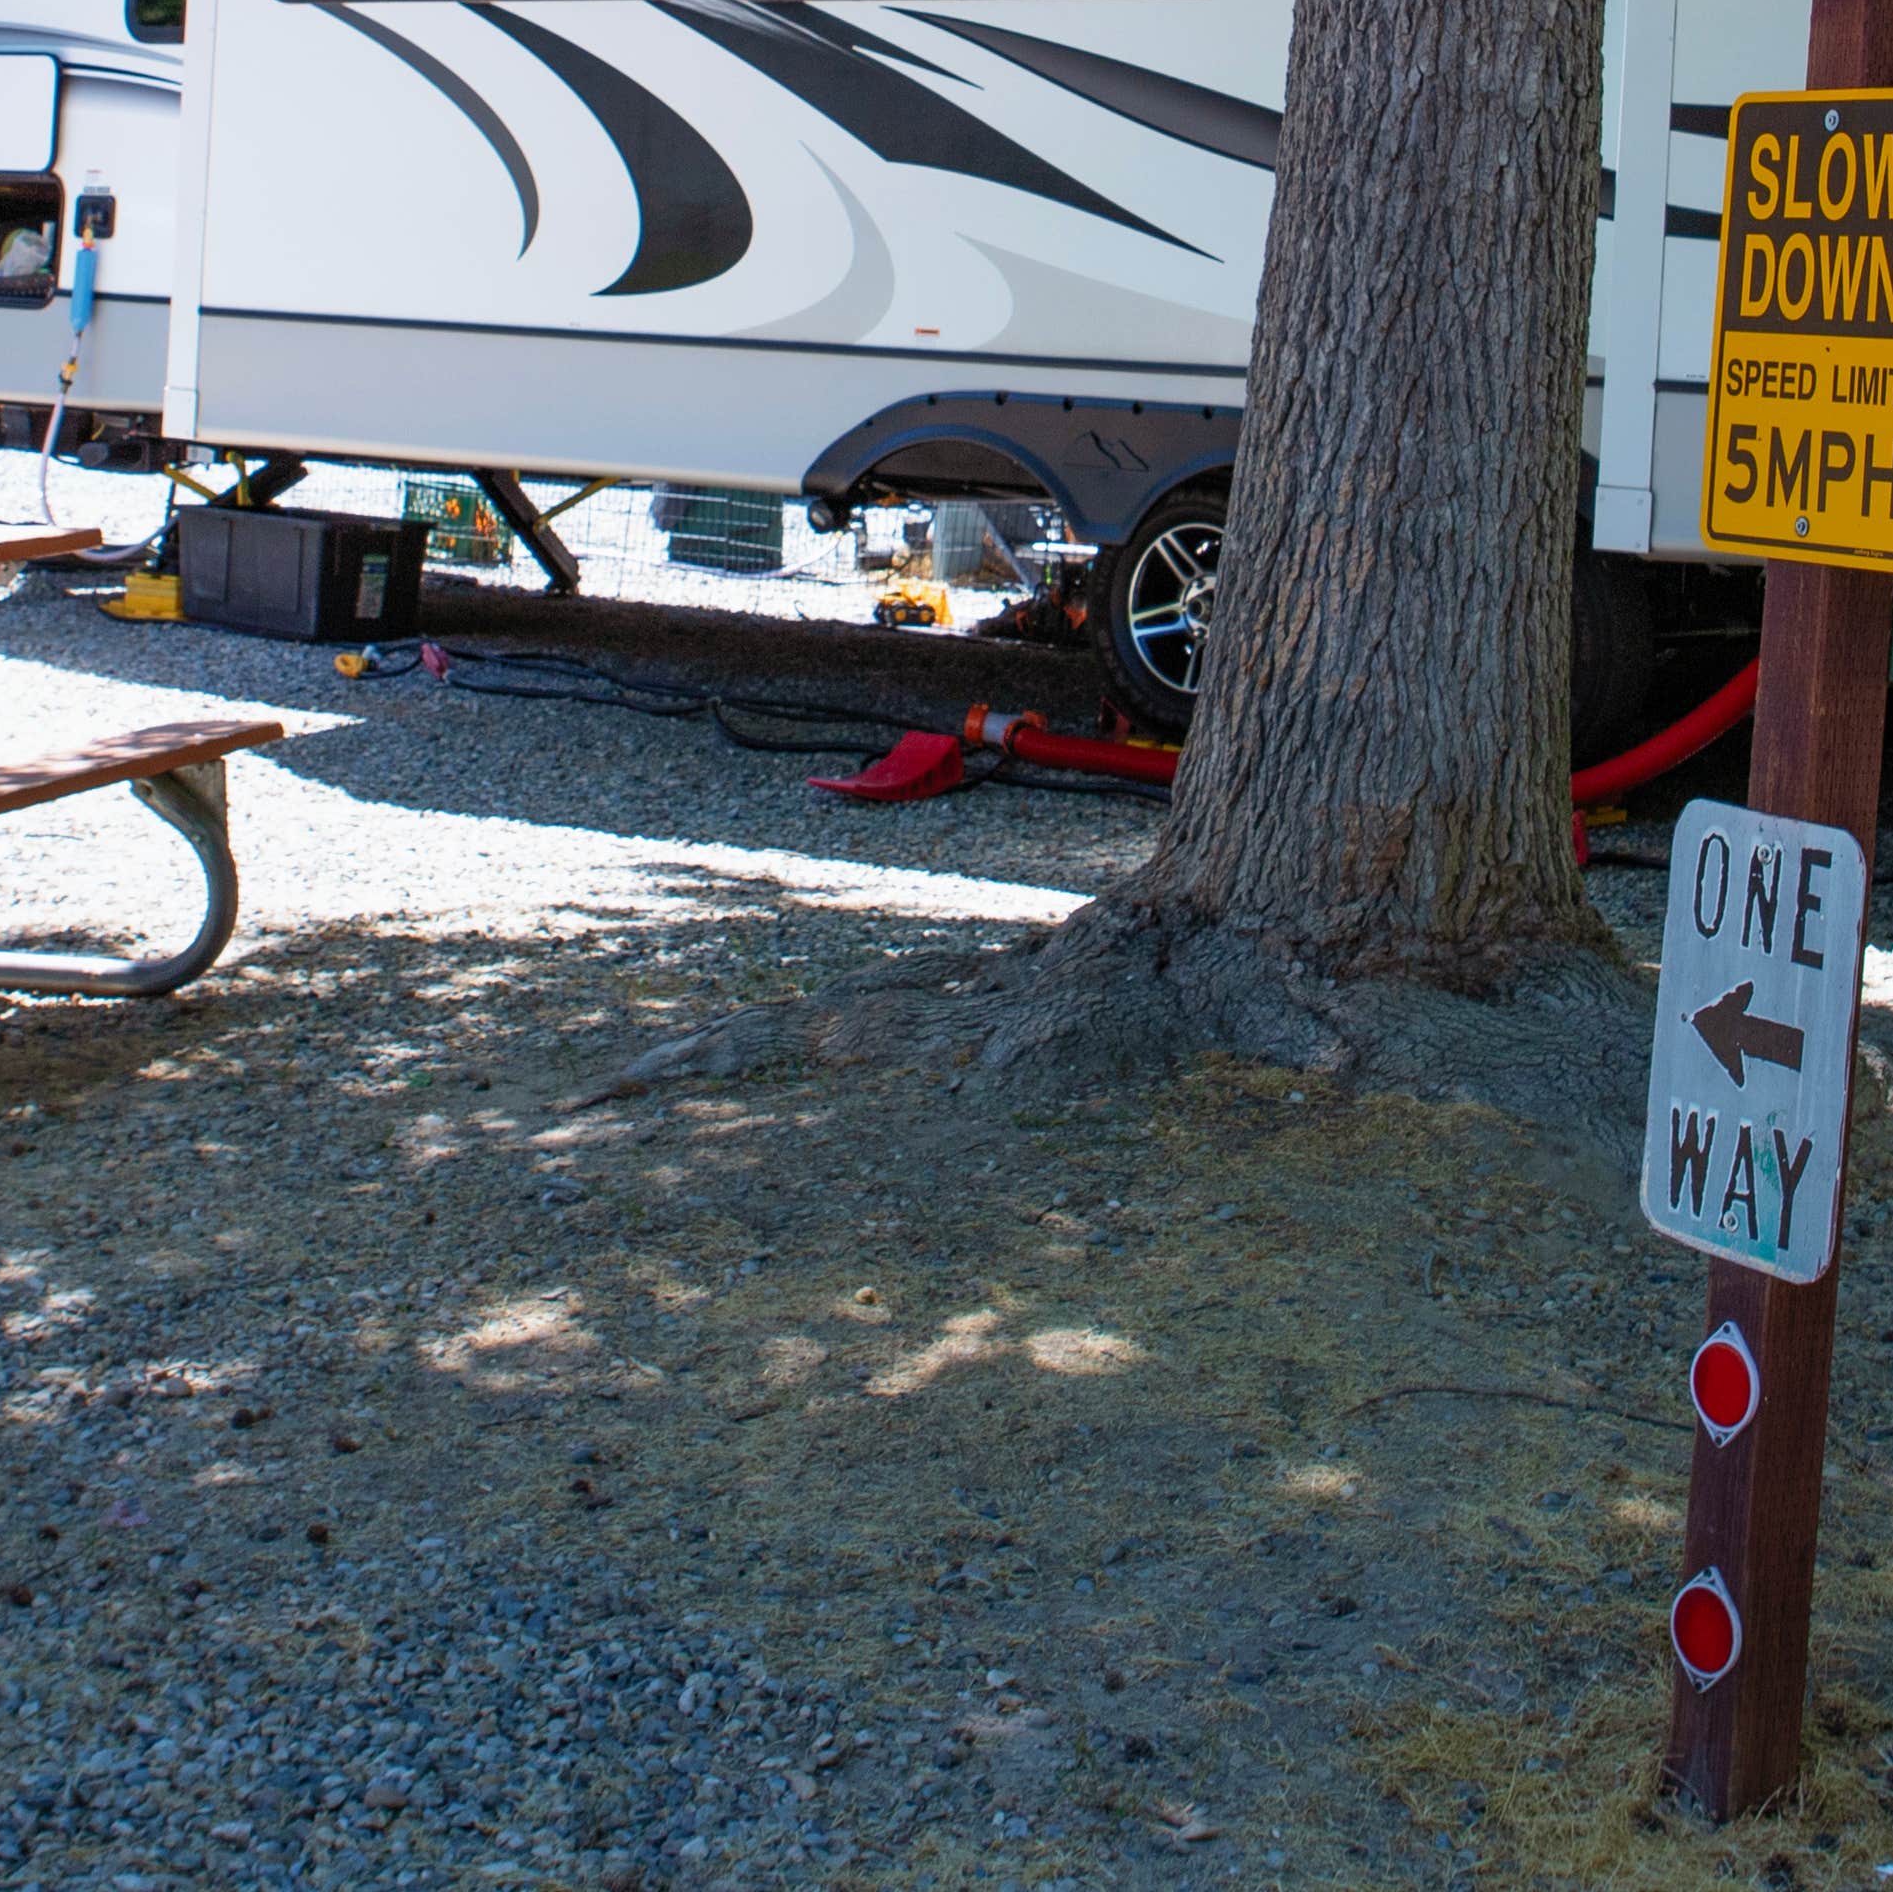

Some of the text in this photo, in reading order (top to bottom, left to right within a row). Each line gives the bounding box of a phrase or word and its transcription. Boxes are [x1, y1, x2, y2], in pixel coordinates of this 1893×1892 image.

[1726, 358, 1817, 401] SPEED
[1693, 832, 1833, 971] ONE
[1669, 1106, 1815, 1251] WAY
